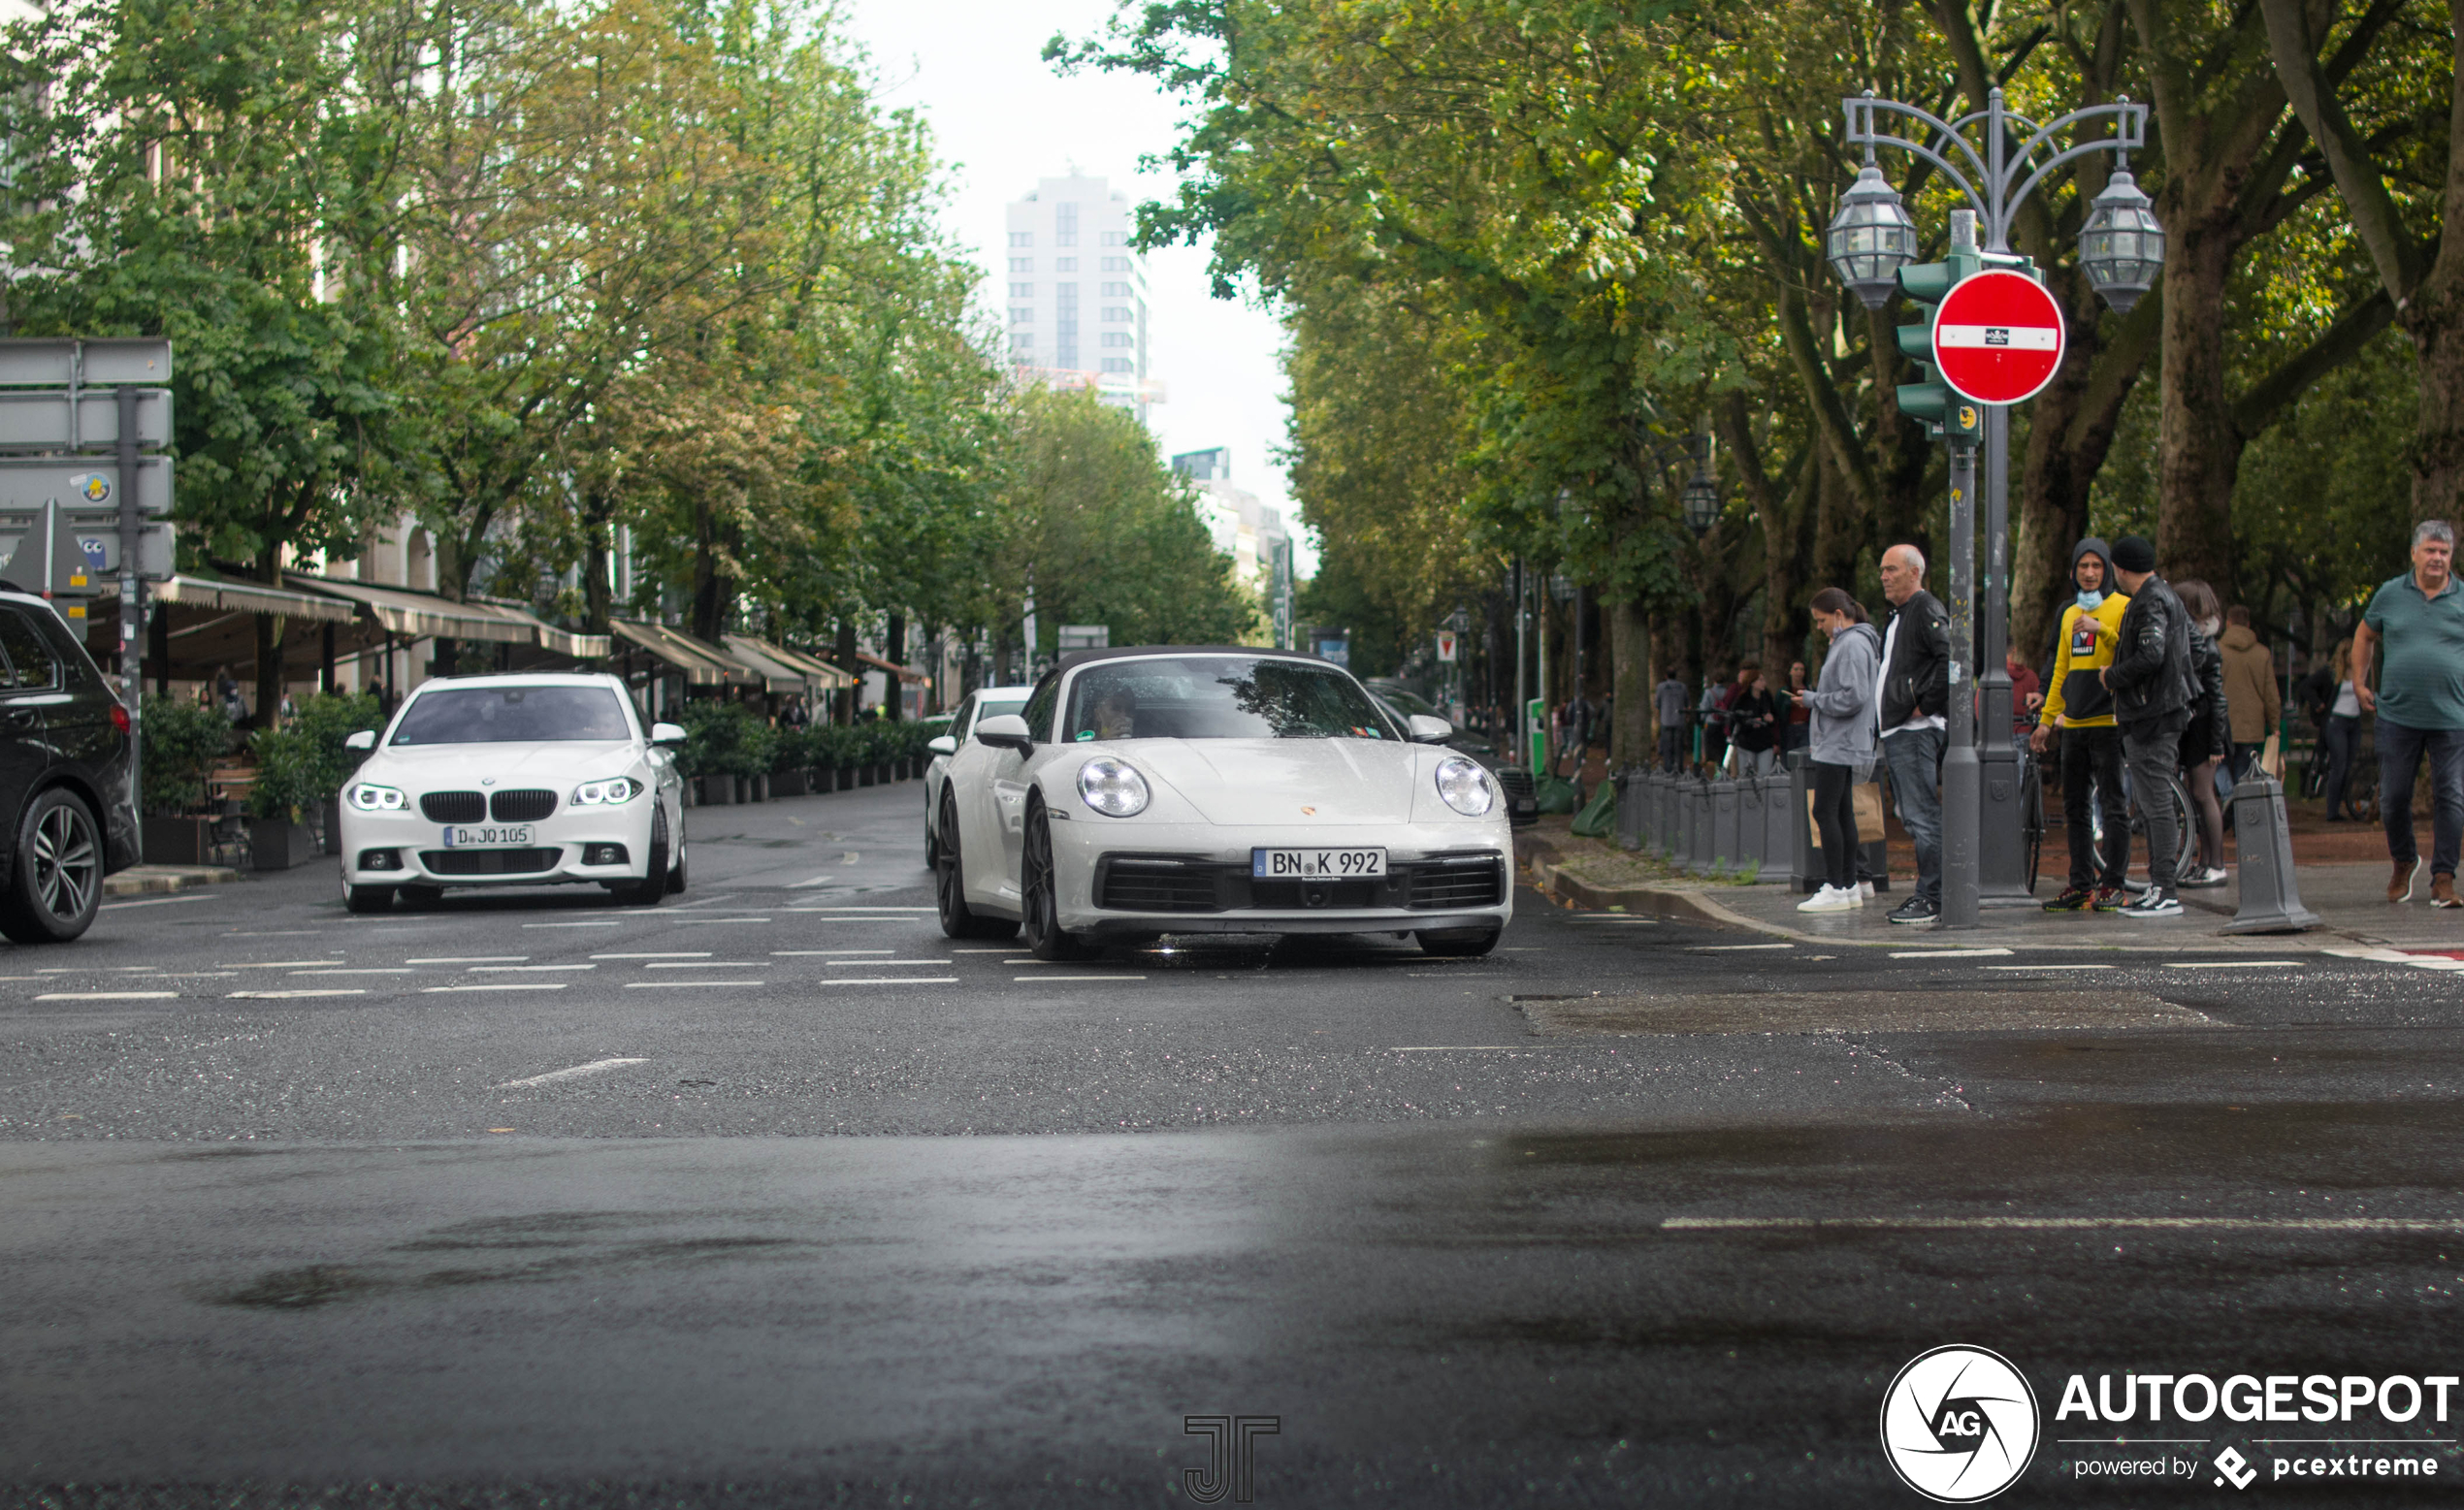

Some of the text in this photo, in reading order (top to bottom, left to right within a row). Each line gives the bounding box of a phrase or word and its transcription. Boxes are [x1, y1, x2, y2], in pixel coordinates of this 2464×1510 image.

[459, 828, 528, 844] D JQ 105
[1273, 851, 1378, 874] BN K 992
